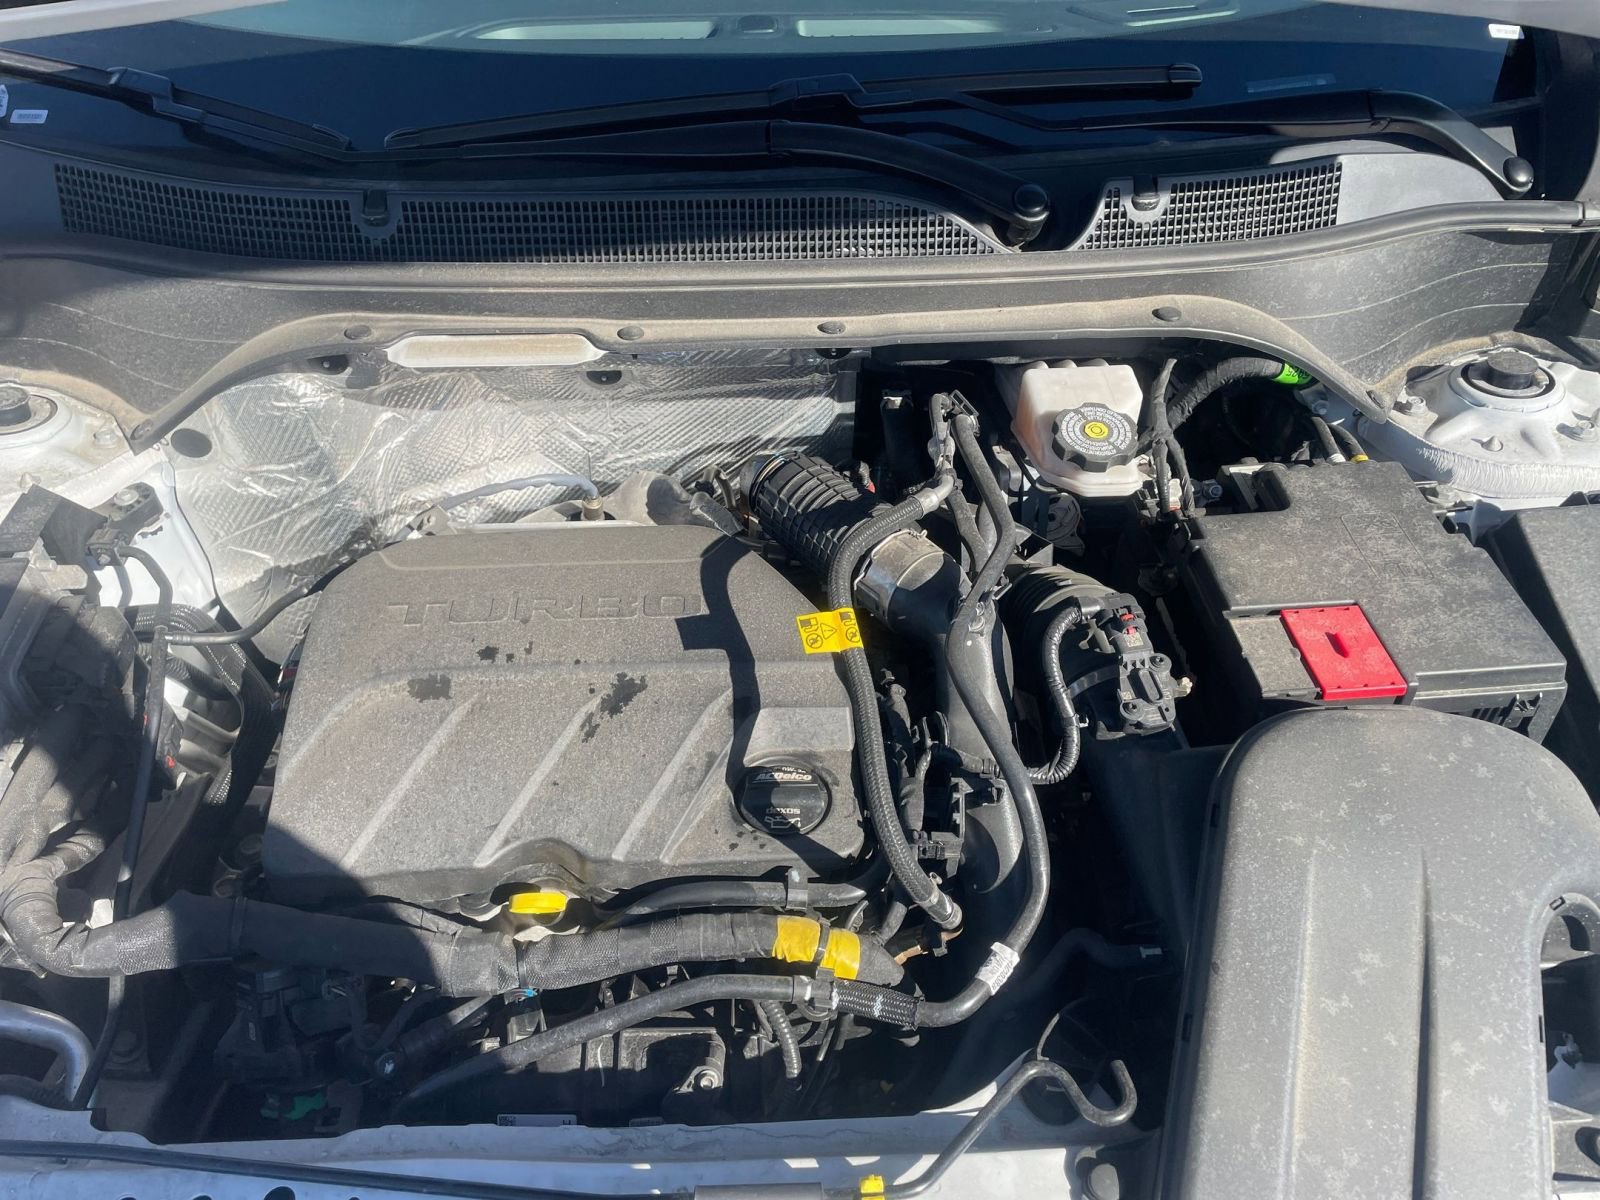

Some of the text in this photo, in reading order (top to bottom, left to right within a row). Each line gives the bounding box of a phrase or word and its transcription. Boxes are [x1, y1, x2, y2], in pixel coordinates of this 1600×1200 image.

[385, 592, 704, 627] TURBO
[756, 772, 812, 781] ACDelco
[766, 806, 801, 815] dexos
